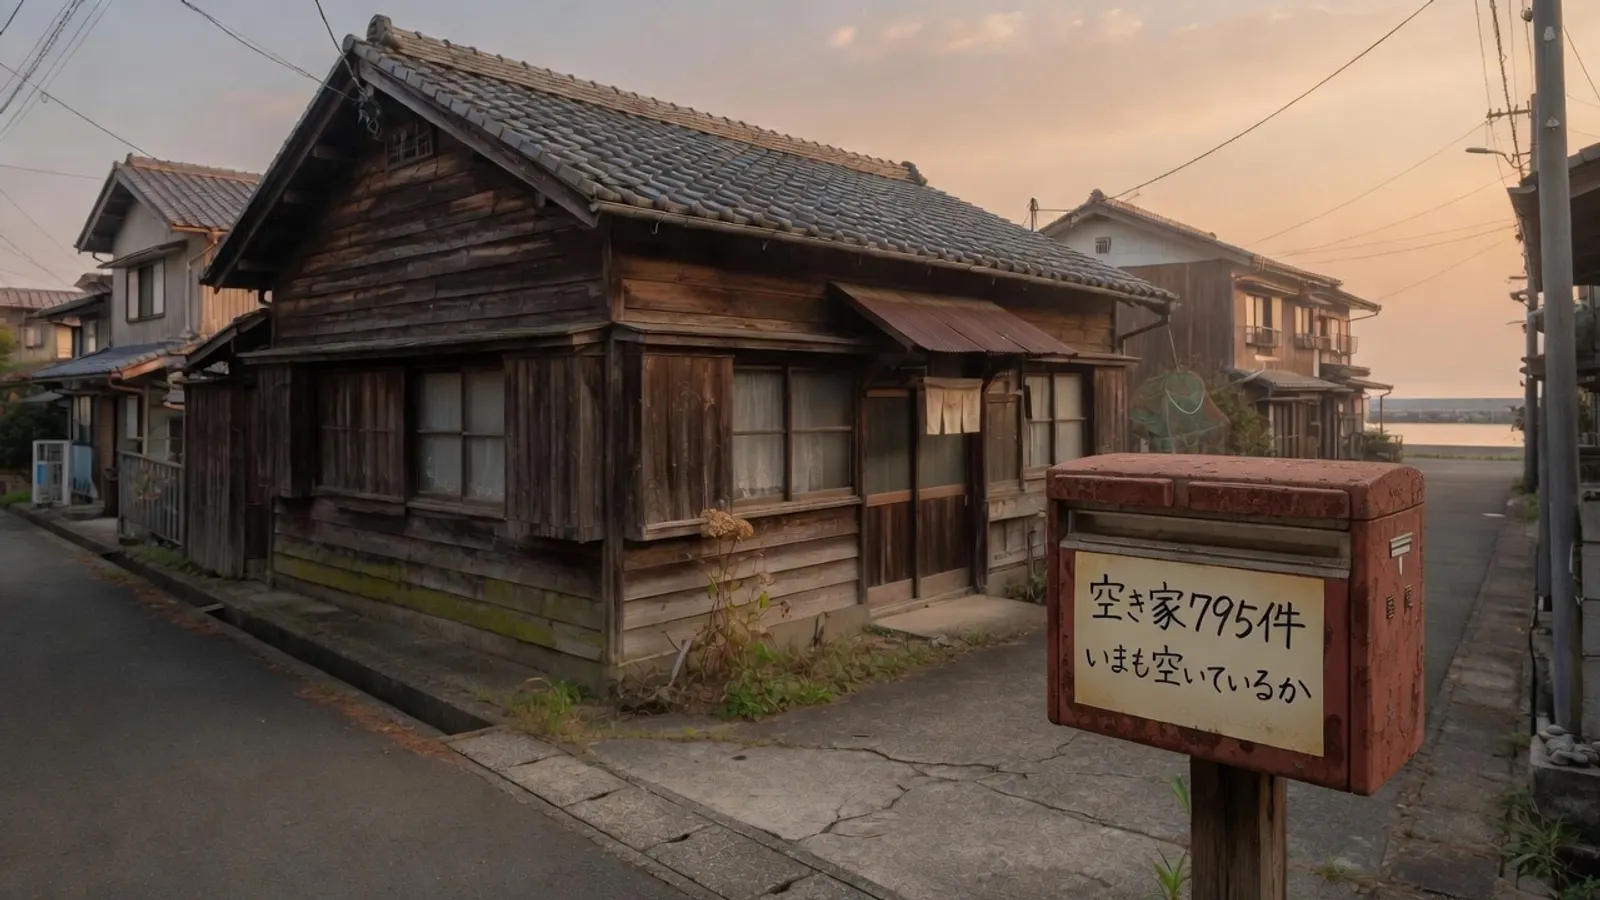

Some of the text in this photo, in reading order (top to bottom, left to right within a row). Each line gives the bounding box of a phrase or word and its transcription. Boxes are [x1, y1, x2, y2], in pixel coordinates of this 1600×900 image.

[1089, 573, 1306, 649] 空き家795件
[1086, 644, 1312, 703] いまも空いているか
